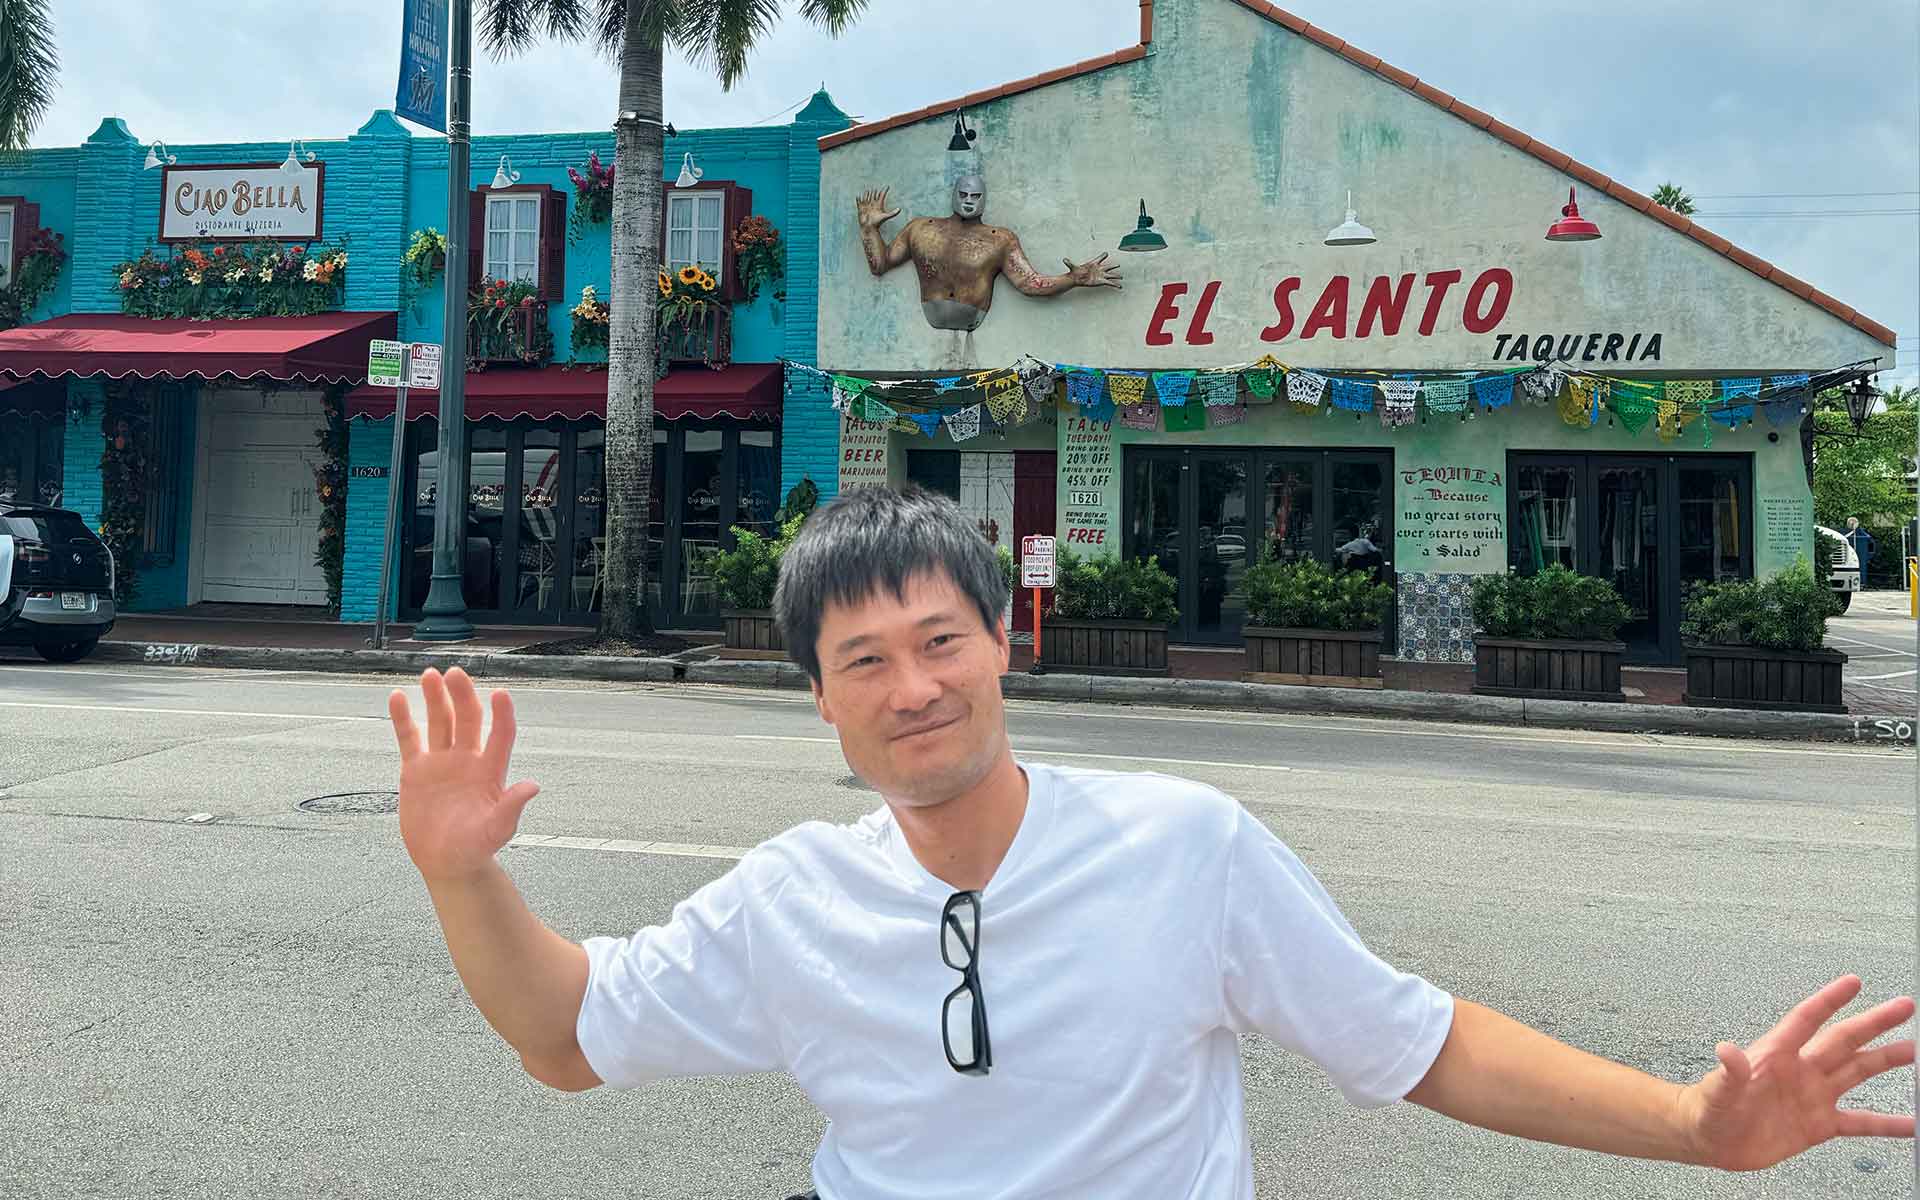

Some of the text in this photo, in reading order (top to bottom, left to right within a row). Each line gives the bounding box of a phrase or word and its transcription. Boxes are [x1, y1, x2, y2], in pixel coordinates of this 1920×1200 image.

[414, 15, 437, 43] LITTLE
[408, 31, 440, 63] HAVANA
[174, 180, 307, 216] CIAO BELLA
[195, 221, 241, 230] RISTORANTE
[1145, 268, 1513, 346] EL SANTO
[1492, 332, 1663, 361] TAQUERIA
[844, 448, 884, 462] BEER
[1067, 453, 1110, 464] 20% OFF
[354, 467, 381, 477] 1620
[840, 467, 886, 476] MARIJUANA
[1400, 467, 1502, 486] TEQUILA
[1067, 475, 1109, 486] 45% OFF
[1072, 493, 1098, 504] 1620
[1404, 511, 1502, 527] no great story
[1066, 528, 1107, 544] FREE
[1397, 527, 1503, 539] ever starts with
[1024, 541, 1034, 553] 10
